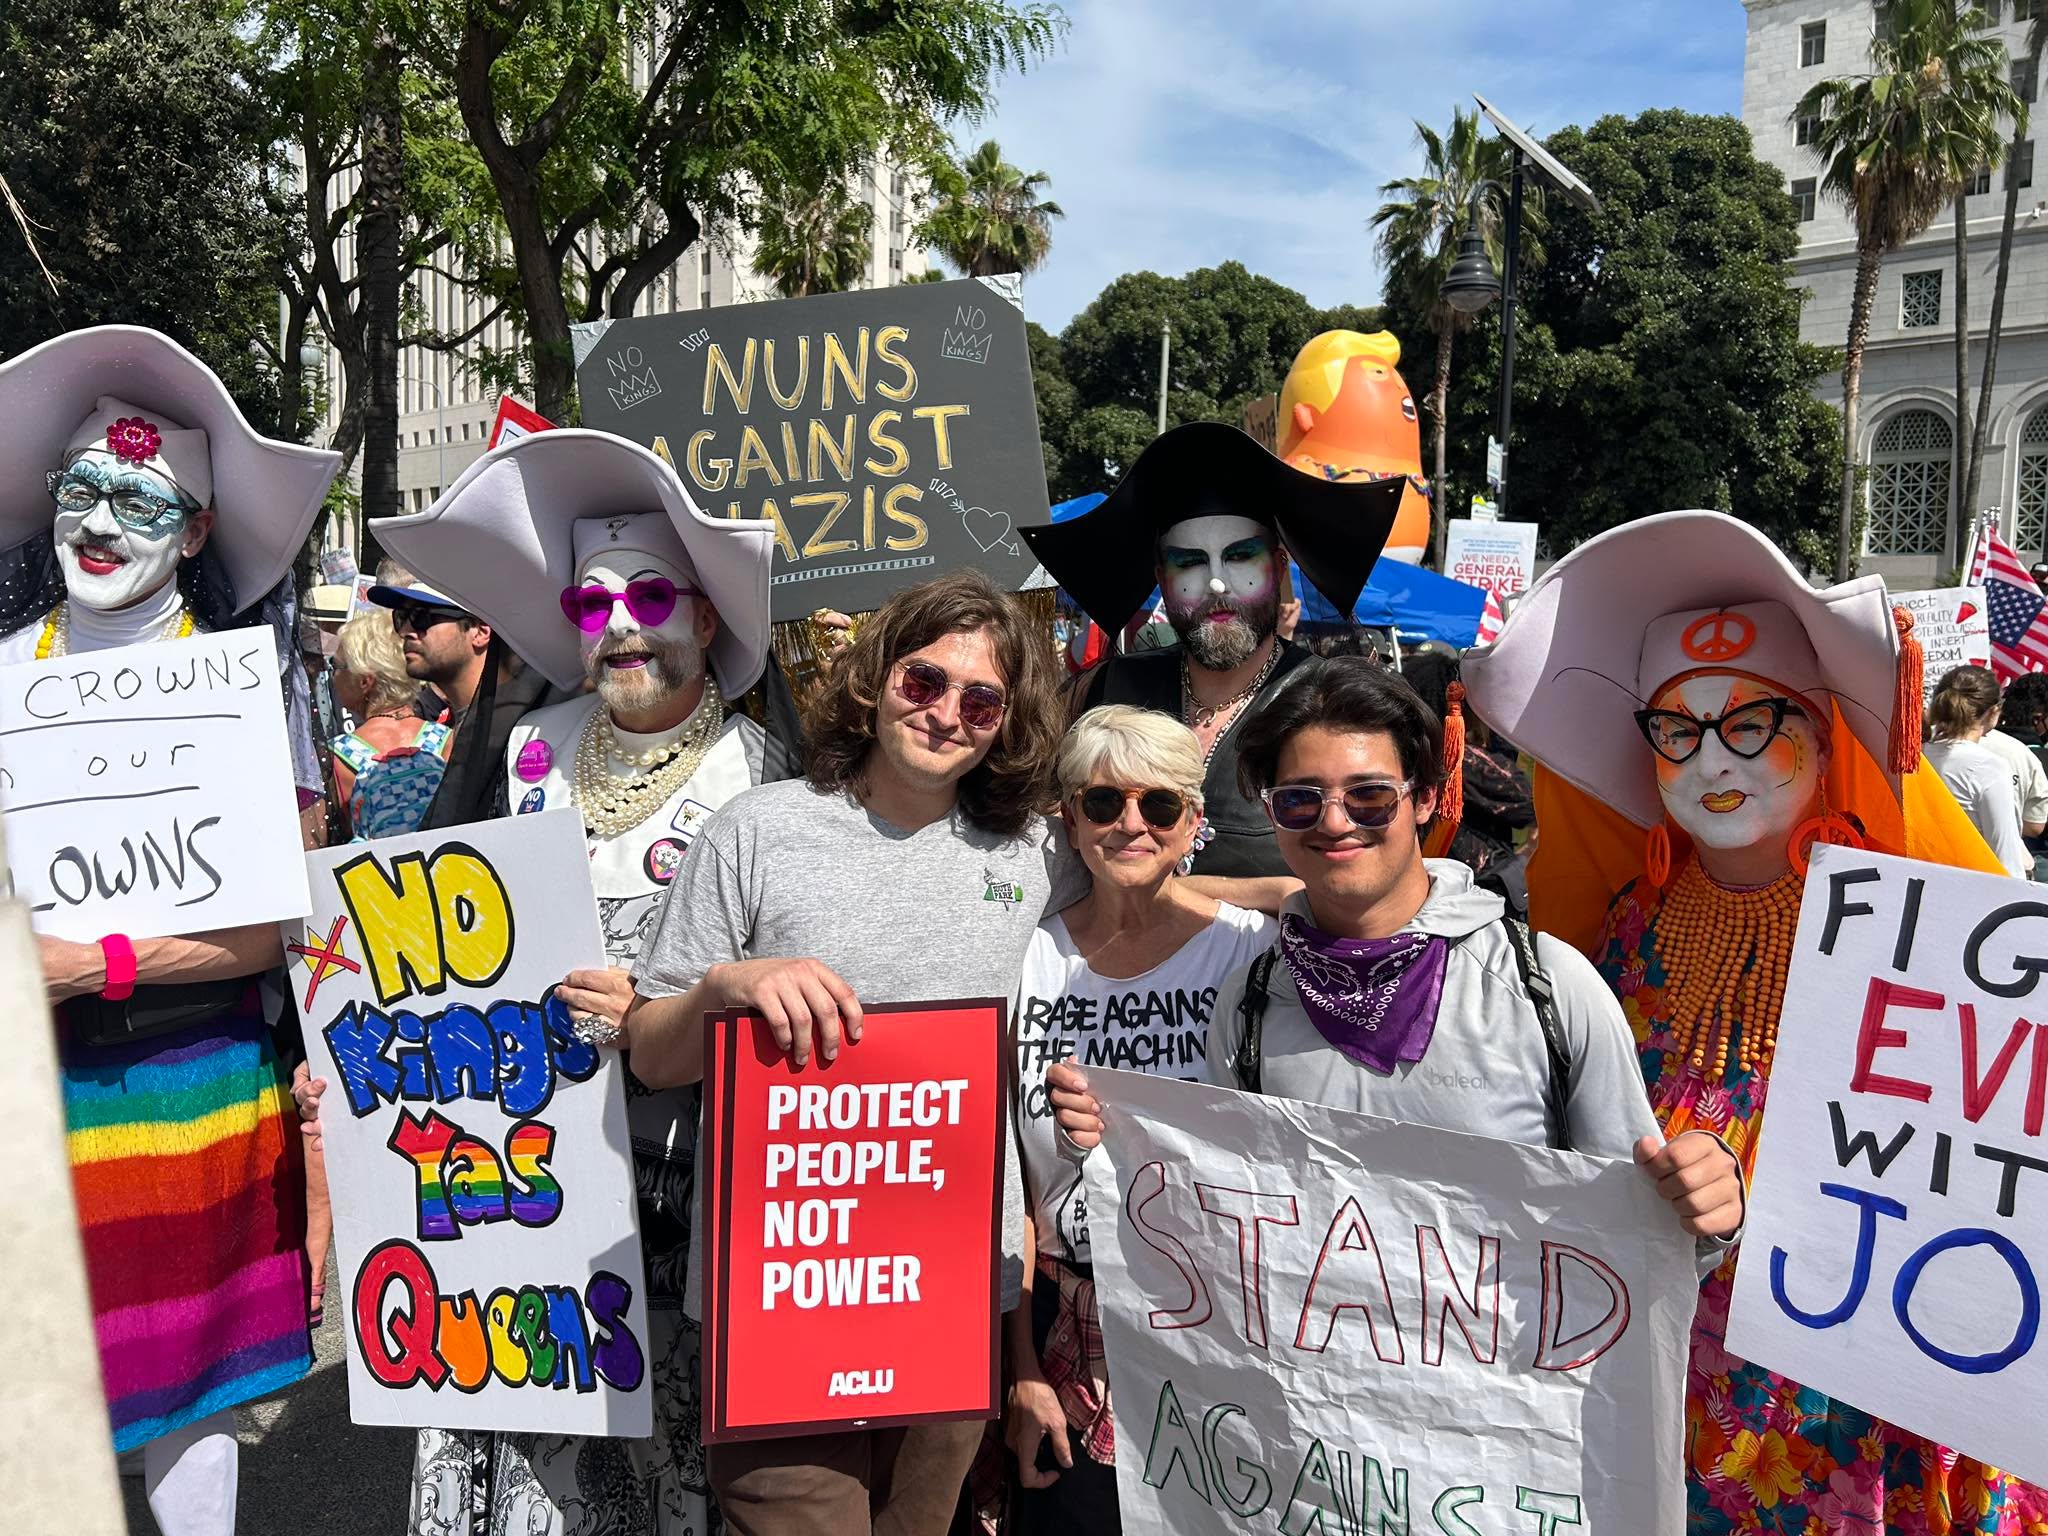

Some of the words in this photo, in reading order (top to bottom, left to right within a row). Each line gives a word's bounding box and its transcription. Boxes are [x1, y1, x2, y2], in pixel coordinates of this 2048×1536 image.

[955, 305, 986, 330] NO
[606, 346, 643, 377] NO
[703, 326, 918, 415] NUNS
[946, 346, 982, 360] KINGS
[622, 383, 656, 405] KINGS
[700, 483, 929, 563] AZIS
[1454, 562, 1525, 578] GENERAL
[1461, 553, 1480, 563] WE
[1481, 554, 1510, 565] NEED
[1512, 556, 1520, 565] A
[25, 649, 261, 719] CROWNS
[88, 744, 195, 776] our
[525, 790, 541, 802] NO
[8, 816, 222, 911] OWNS
[992, 883, 1012, 893] SOUTH
[994, 891, 1014, 900] PARK
[333, 842, 514, 1007] NO
[1818, 867, 2048, 999] FIG
[1023, 994, 1098, 1037] RAGE
[1101, 986, 1219, 1036] AGAINS
[322, 983, 600, 1118] Kings
[1017, 1036, 1076, 1080] THE
[1084, 1029, 1208, 1073] MACHIN
[1849, 976, 2048, 1137] EVI
[768, 1079, 968, 1130] PROTECT
[387, 1106, 563, 1241] Yas
[765, 1139, 945, 1191] PEOPLE,
[1826, 1100, 2048, 1218] WIT
[763, 1198, 858, 1248] NOT
[762, 1255, 921, 1310] POWER
[1126, 1161, 1631, 1371] STAND
[1769, 1181, 2041, 1375] JO
[352, 1237, 645, 1394] Queens
[828, 1369, 894, 1396] ACLU
